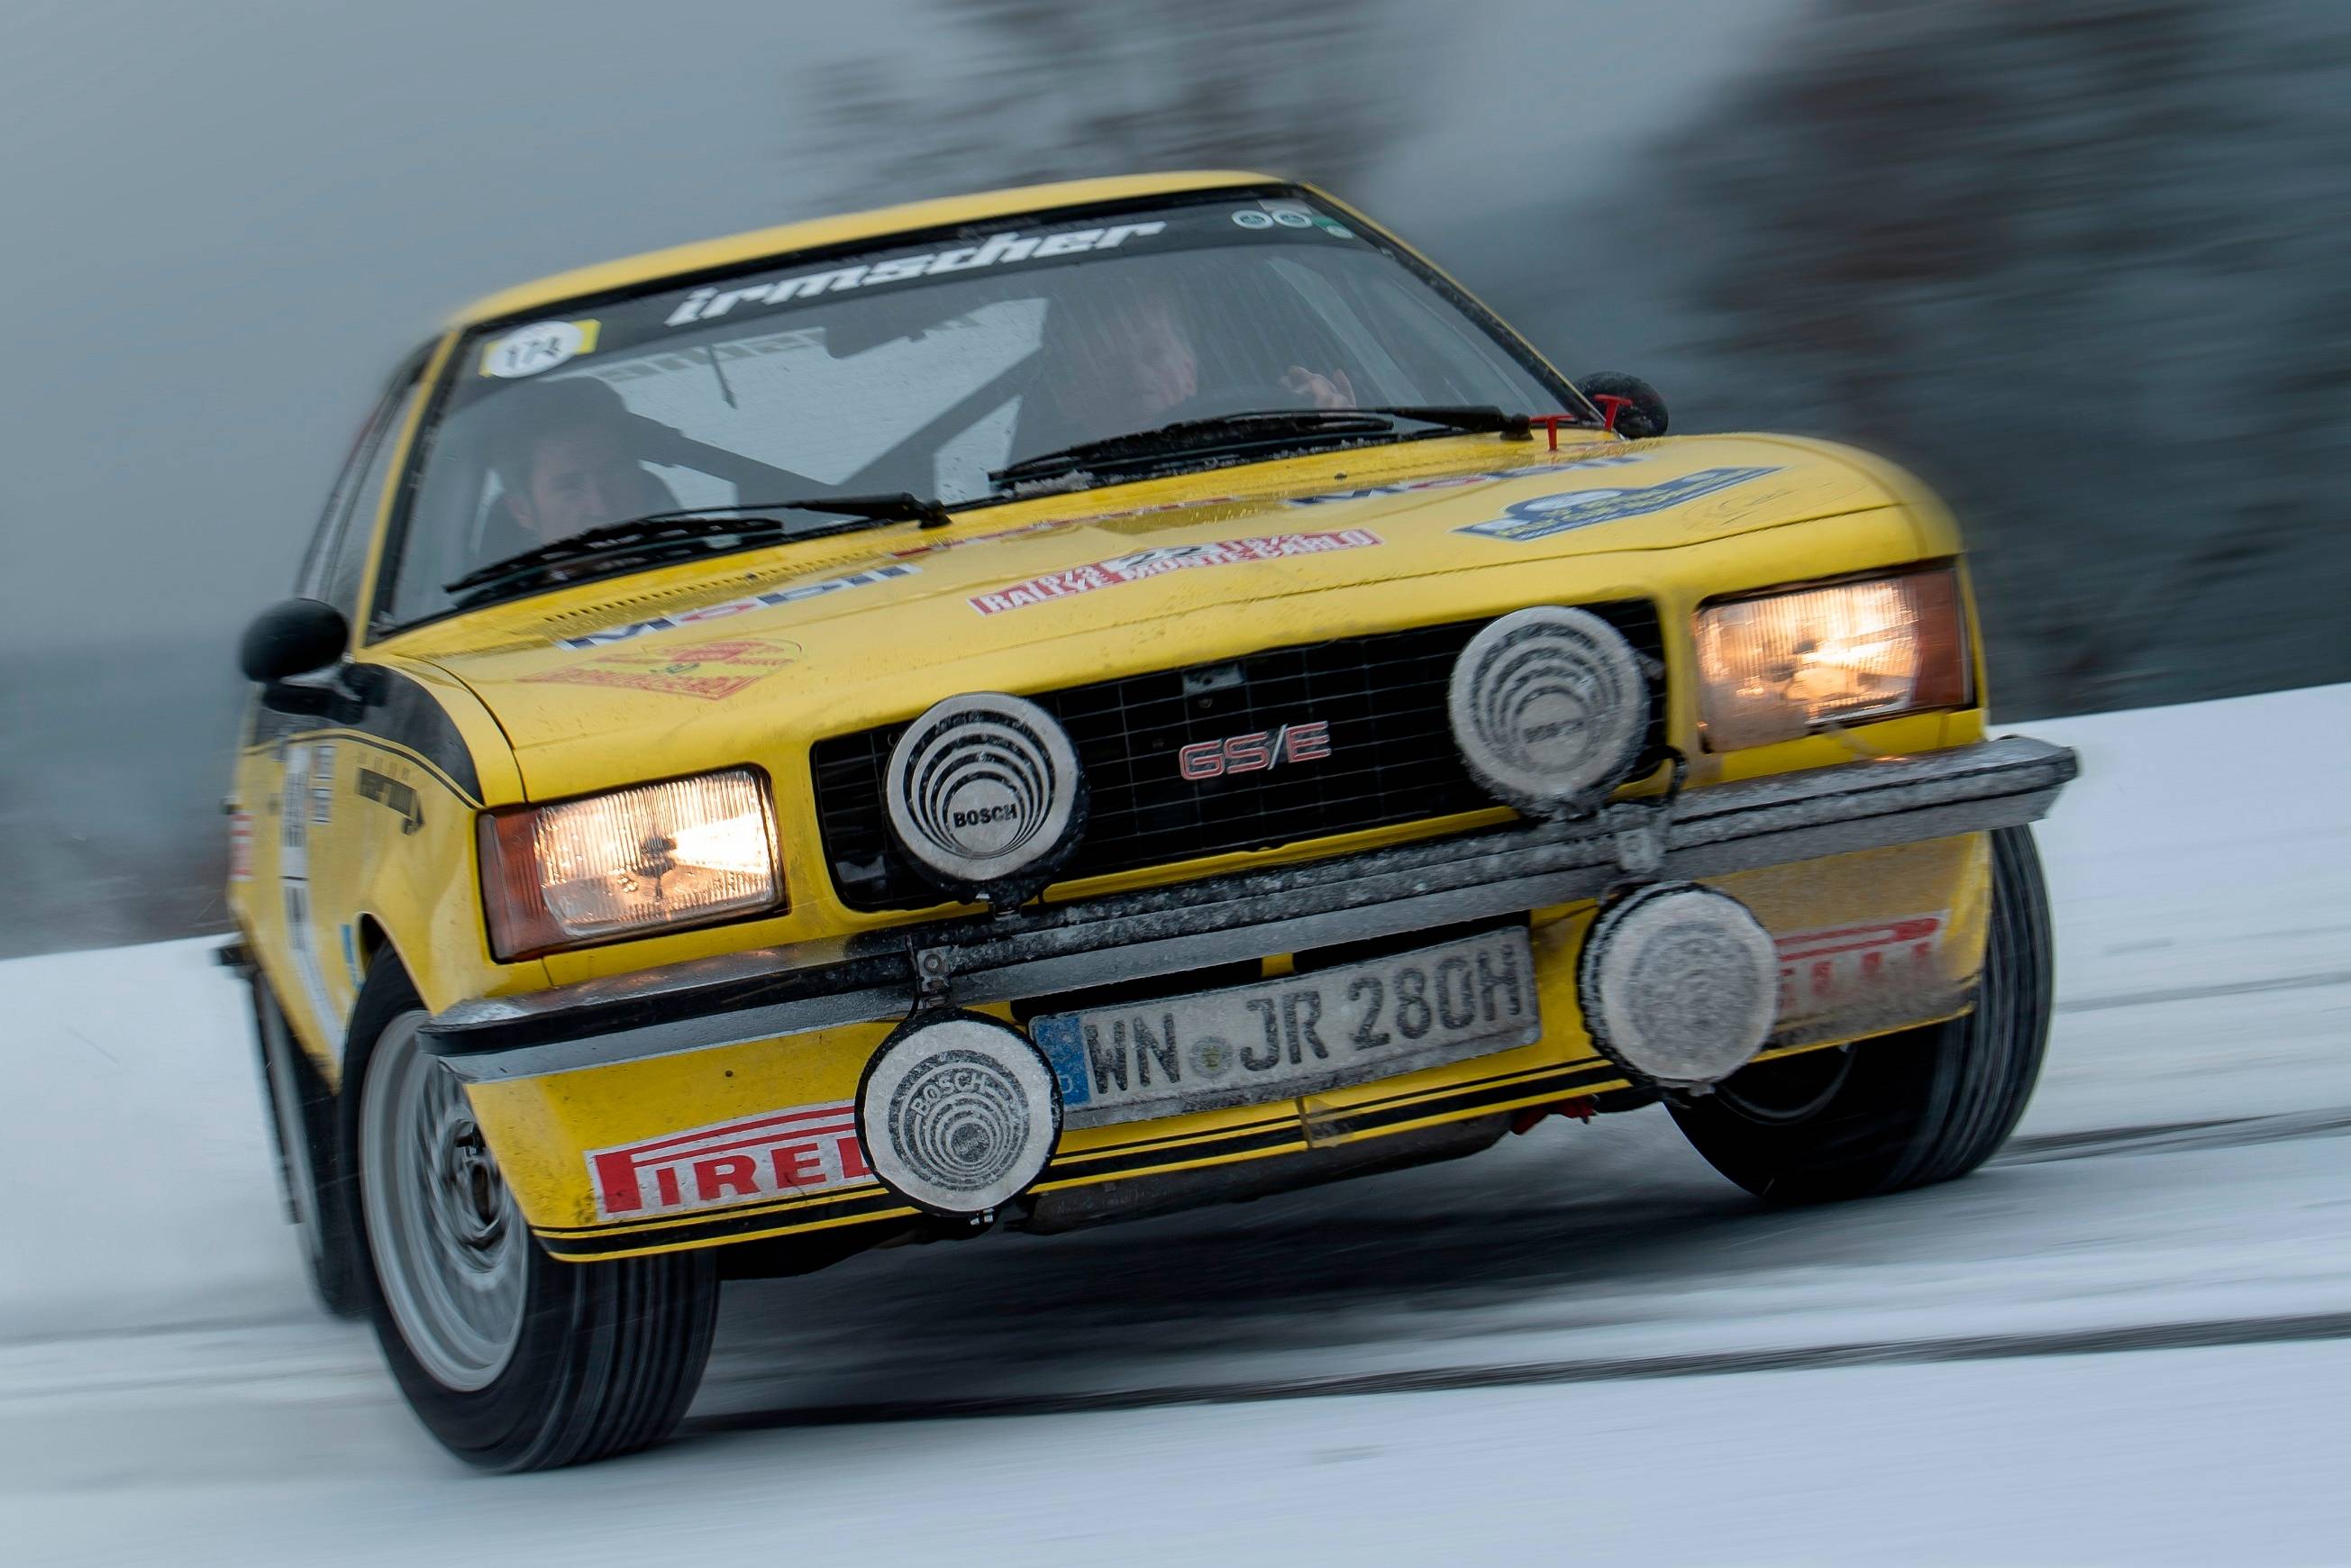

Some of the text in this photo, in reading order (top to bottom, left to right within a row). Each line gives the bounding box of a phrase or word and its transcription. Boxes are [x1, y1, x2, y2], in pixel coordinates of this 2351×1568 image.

[664, 221, 1167, 327] irmscher
[1179, 721, 1332, 780] GS/E
[952, 804, 1019, 828] BOSCH
[1084, 944, 1521, 1094] WN JR 280H
[911, 1070, 990, 1117] BOSCH
[595, 1105, 876, 1213] PIREL
